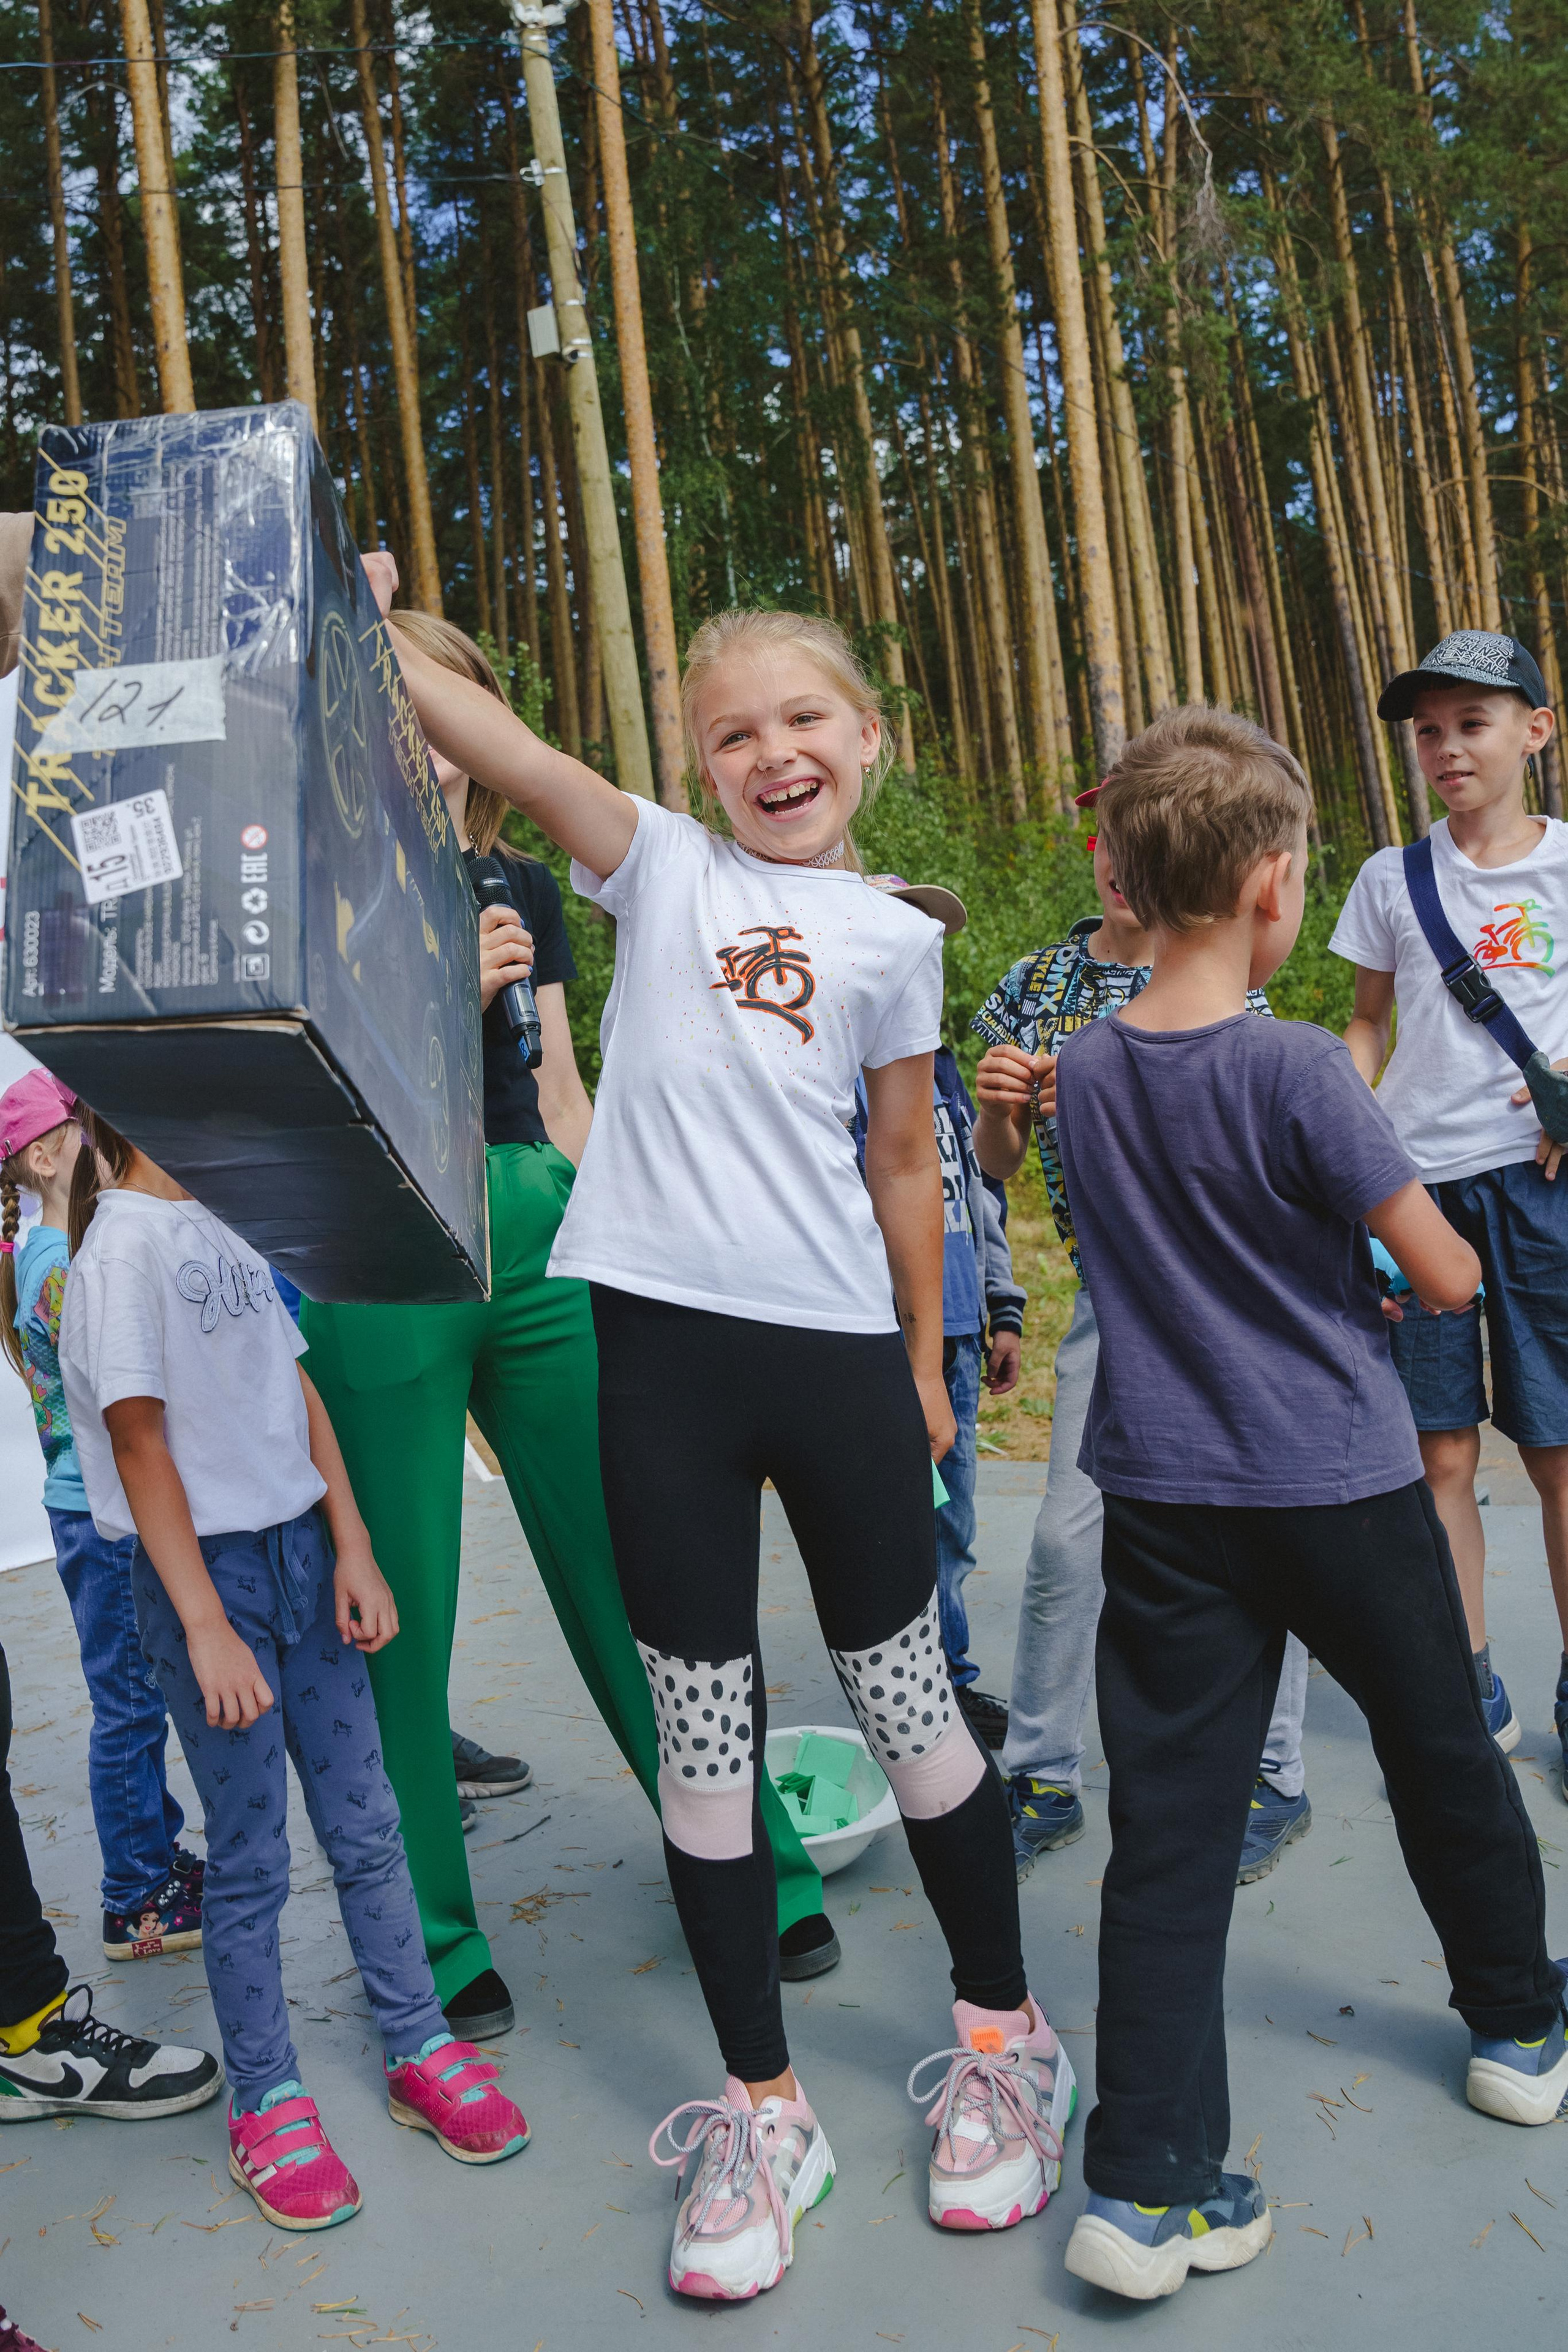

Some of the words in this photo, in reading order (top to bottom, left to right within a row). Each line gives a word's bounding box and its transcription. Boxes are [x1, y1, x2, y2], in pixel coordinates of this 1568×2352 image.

[44, 470, 89, 554] 250
[1461, 642, 1509, 669] KENZO
[1470, 655, 1507, 676] KENZ
[375, 620, 428, 799] TRACKER
[1029, 950, 1057, 992] STYLE
[1036, 1125, 1066, 1209] BMX
